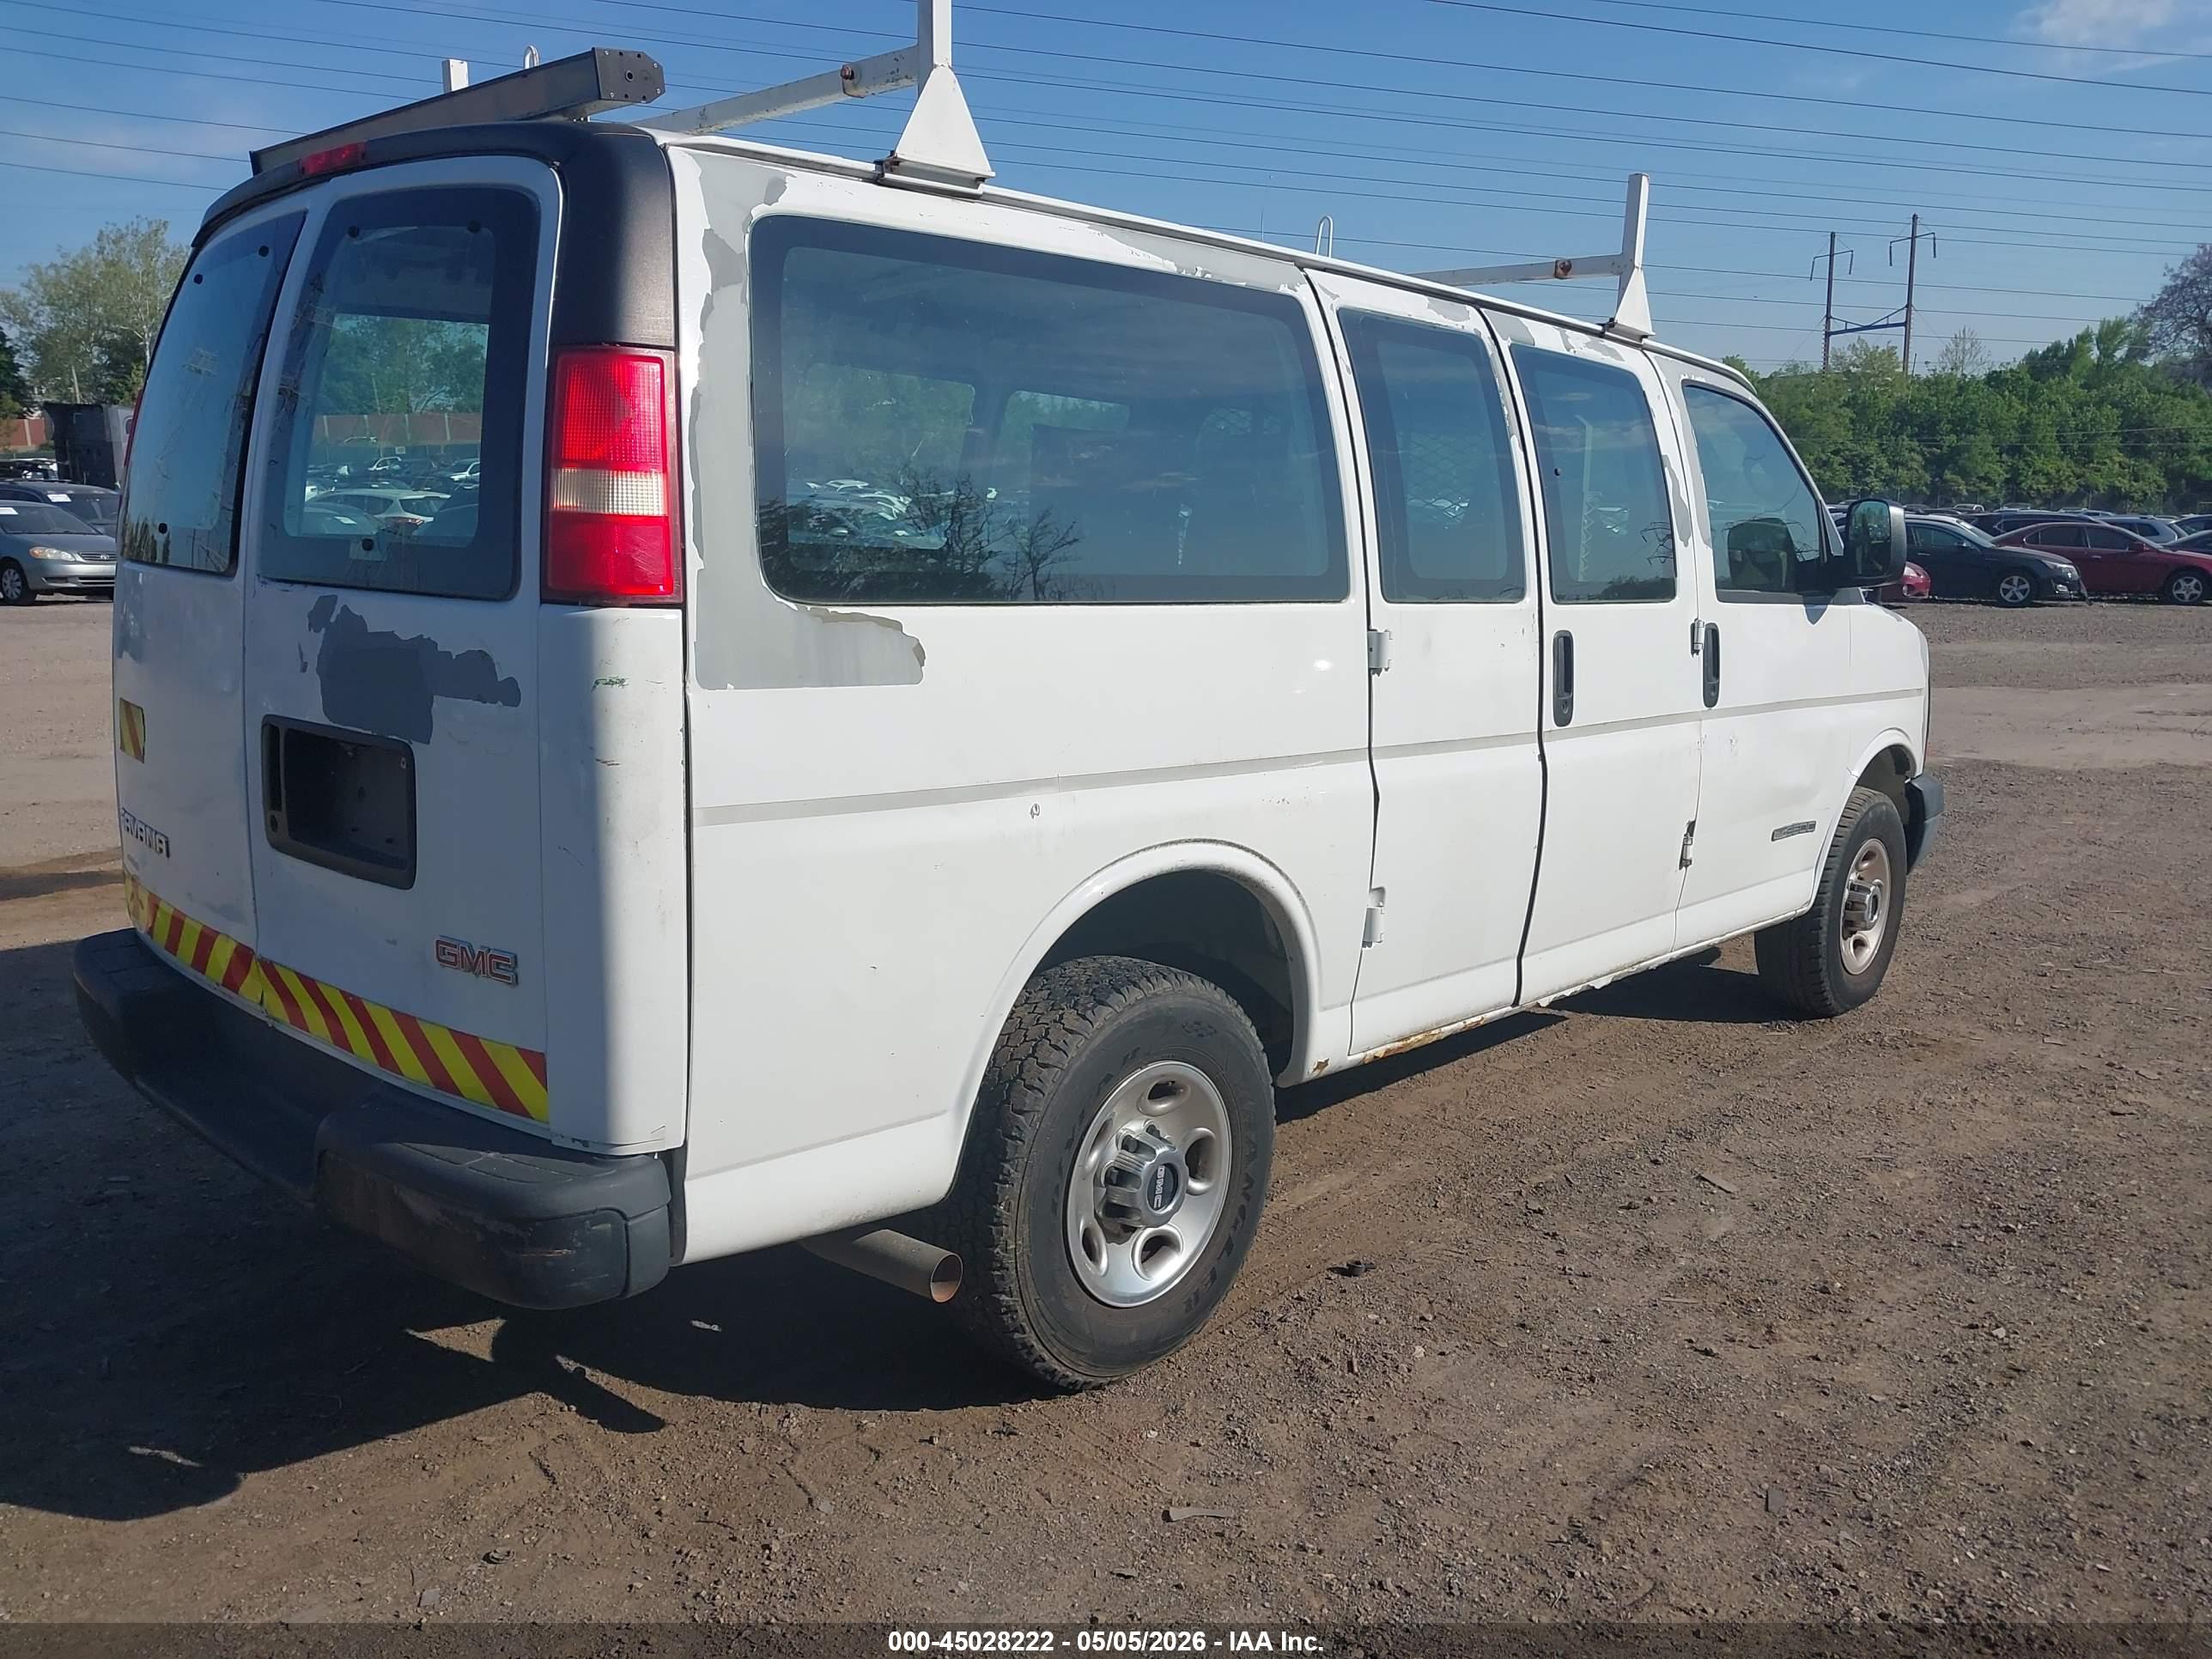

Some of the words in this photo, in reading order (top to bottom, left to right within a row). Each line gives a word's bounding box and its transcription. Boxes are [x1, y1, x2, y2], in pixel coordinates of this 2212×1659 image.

[121, 807, 170, 858] AVANA
[434, 935, 519, 986] GMC
[1153, 1164, 1165, 1209] GMC
